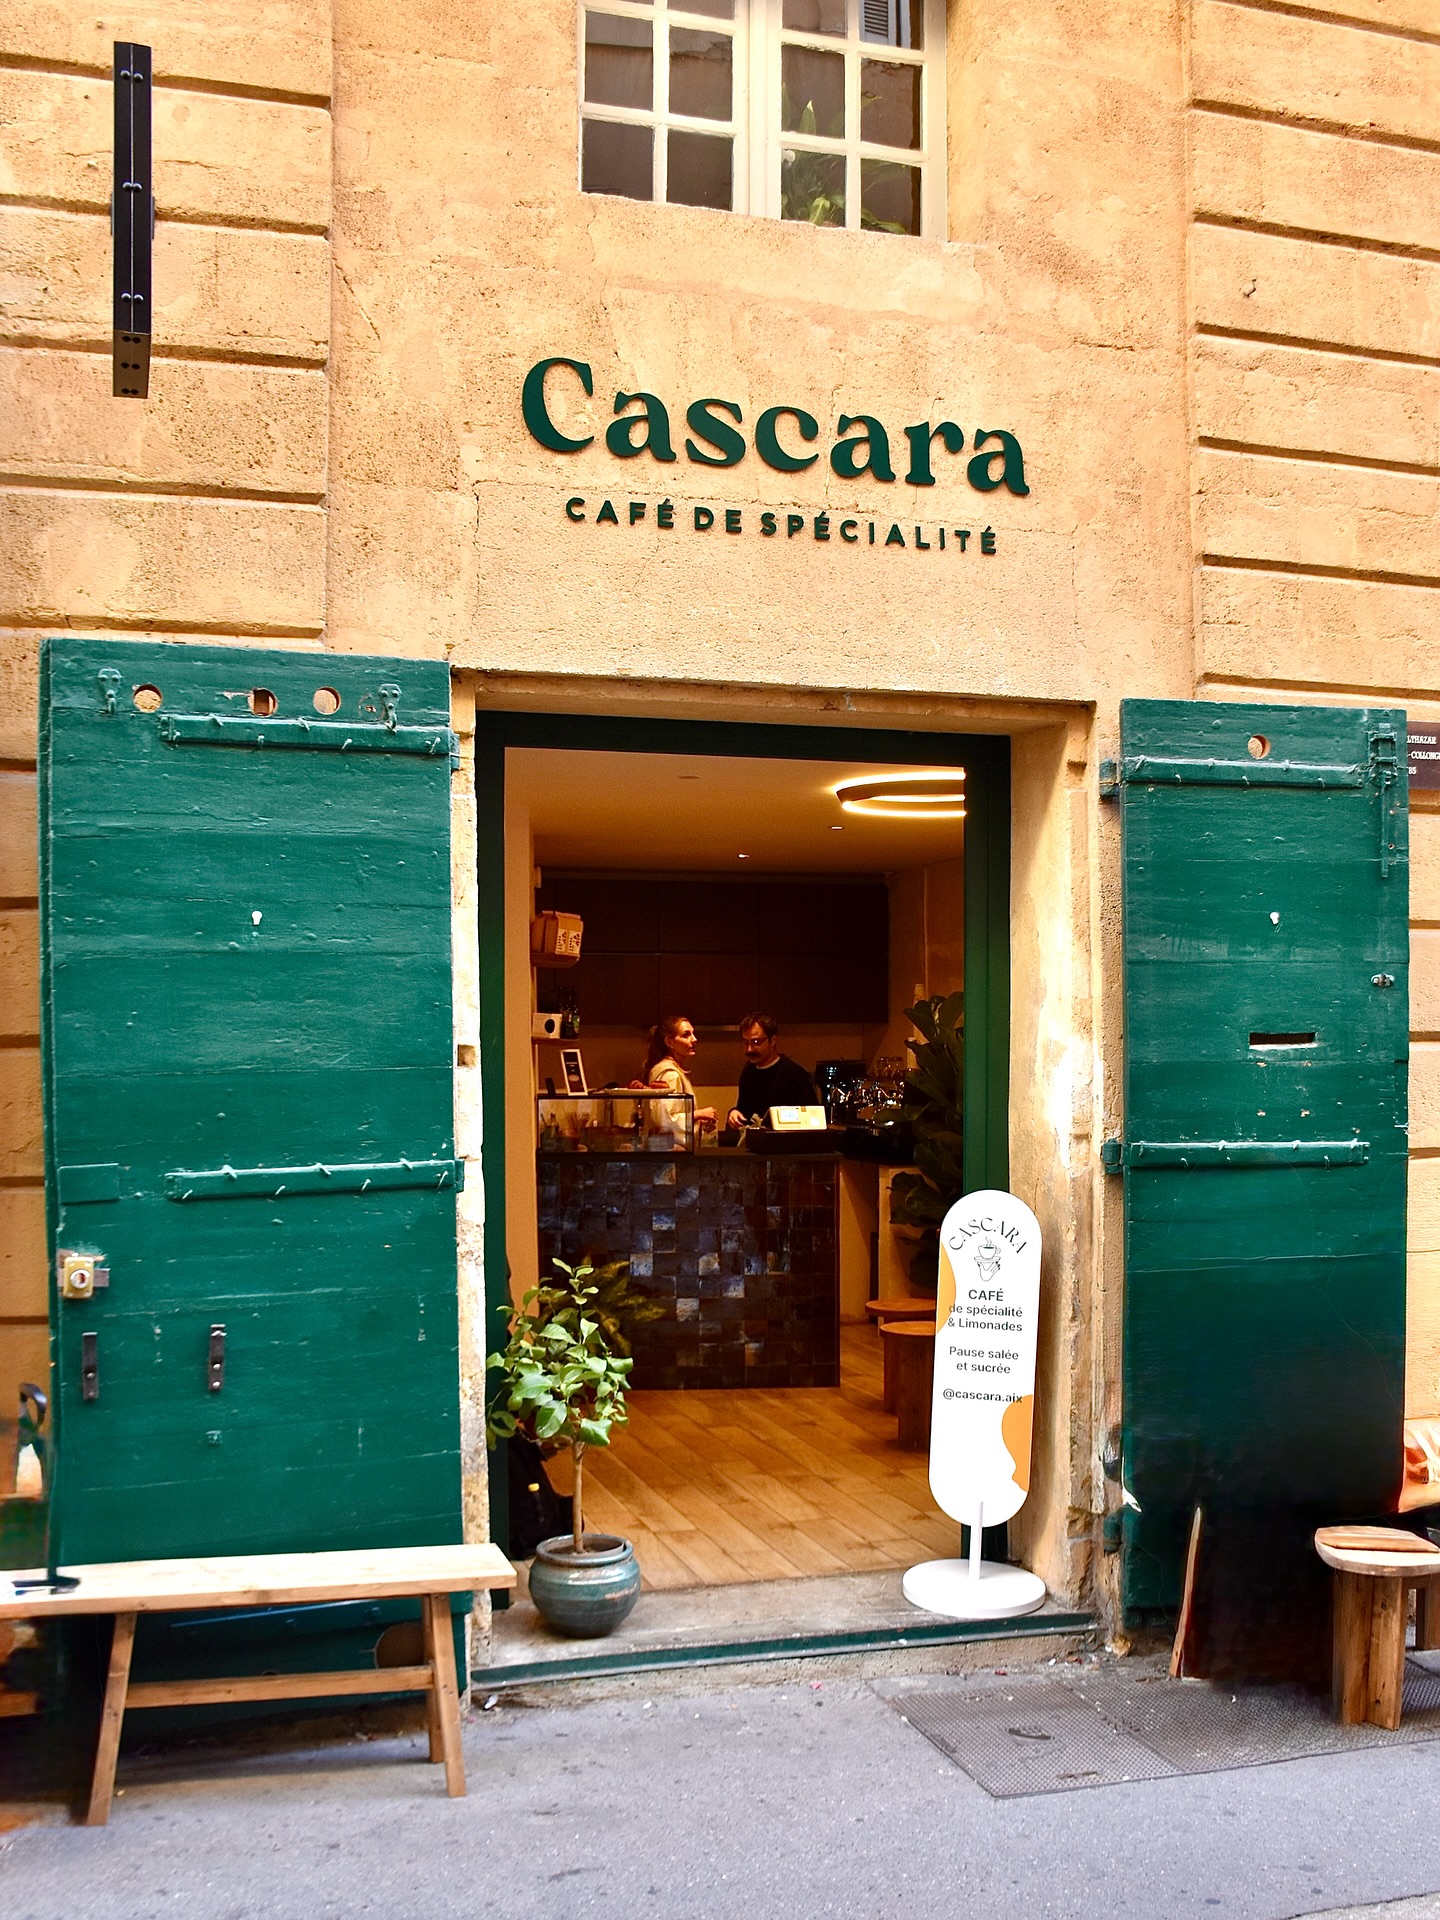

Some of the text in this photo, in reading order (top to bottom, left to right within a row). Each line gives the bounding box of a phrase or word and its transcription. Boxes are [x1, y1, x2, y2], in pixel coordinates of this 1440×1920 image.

[521, 357, 1031, 499] Cascara
[565, 497, 997, 556] CAFÉ DE SPÉCIALITÉ
[1406, 734, 1437, 745] LTHAZAR
[948, 1217, 1028, 1254] CASCARA
[968, 1288, 1004, 1302] CAFÉ
[948, 1304, 1023, 1318] de spécialité
[947, 1317, 1023, 1332] & Limonades
[949, 1345, 1019, 1361] Pause salée
[956, 1362, 1011, 1374] et sucrée
[942, 1388, 1023, 1403] @cascara.aix
